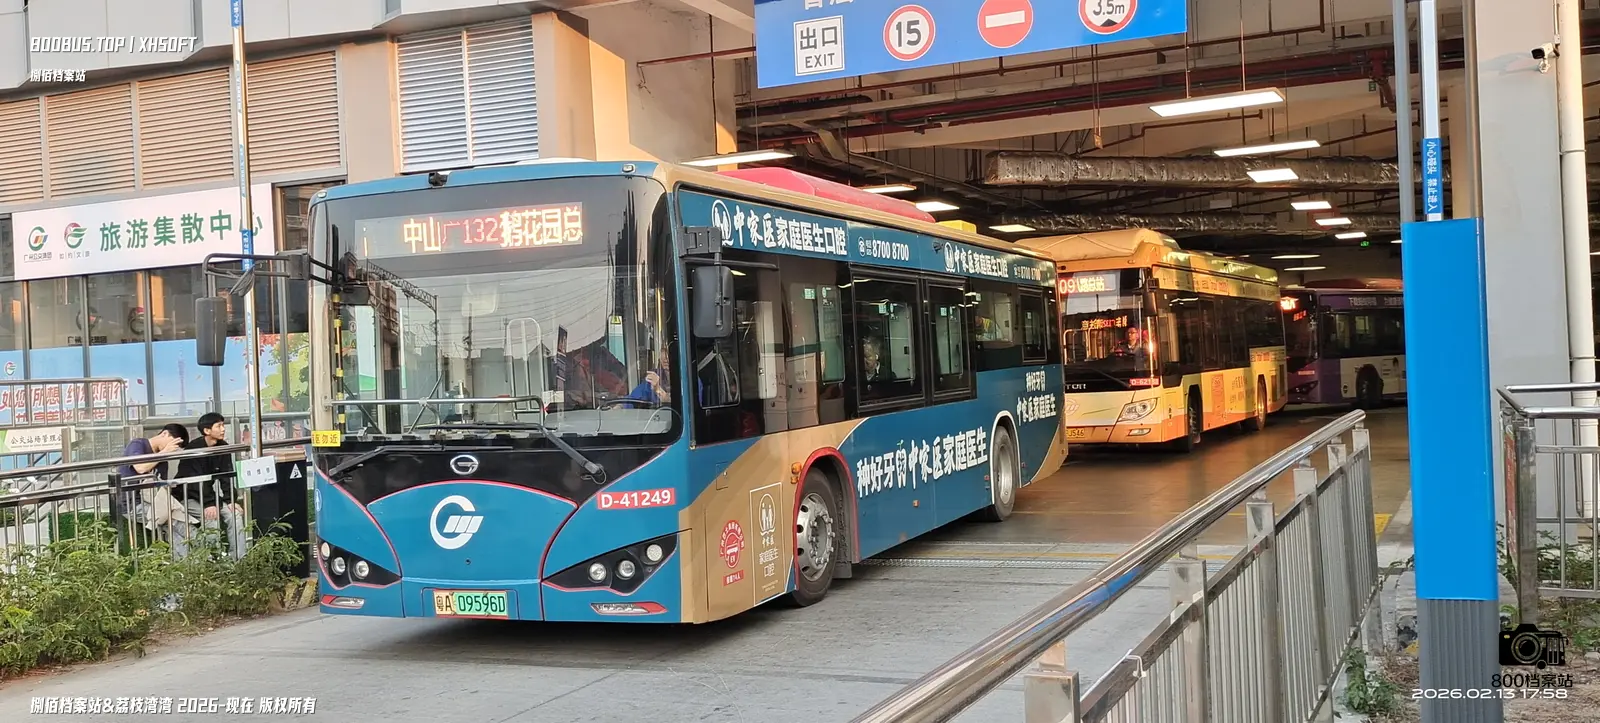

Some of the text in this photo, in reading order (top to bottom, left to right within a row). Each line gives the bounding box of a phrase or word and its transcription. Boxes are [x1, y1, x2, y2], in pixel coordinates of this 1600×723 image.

[800, 26, 838, 50] 出口
[896, 20, 922, 48] 15
[805, 53, 835, 68] EXIT
[872, 239, 891, 259] 8700
[892, 242, 910, 262] 8700
[601, 490, 671, 508] D-41249
